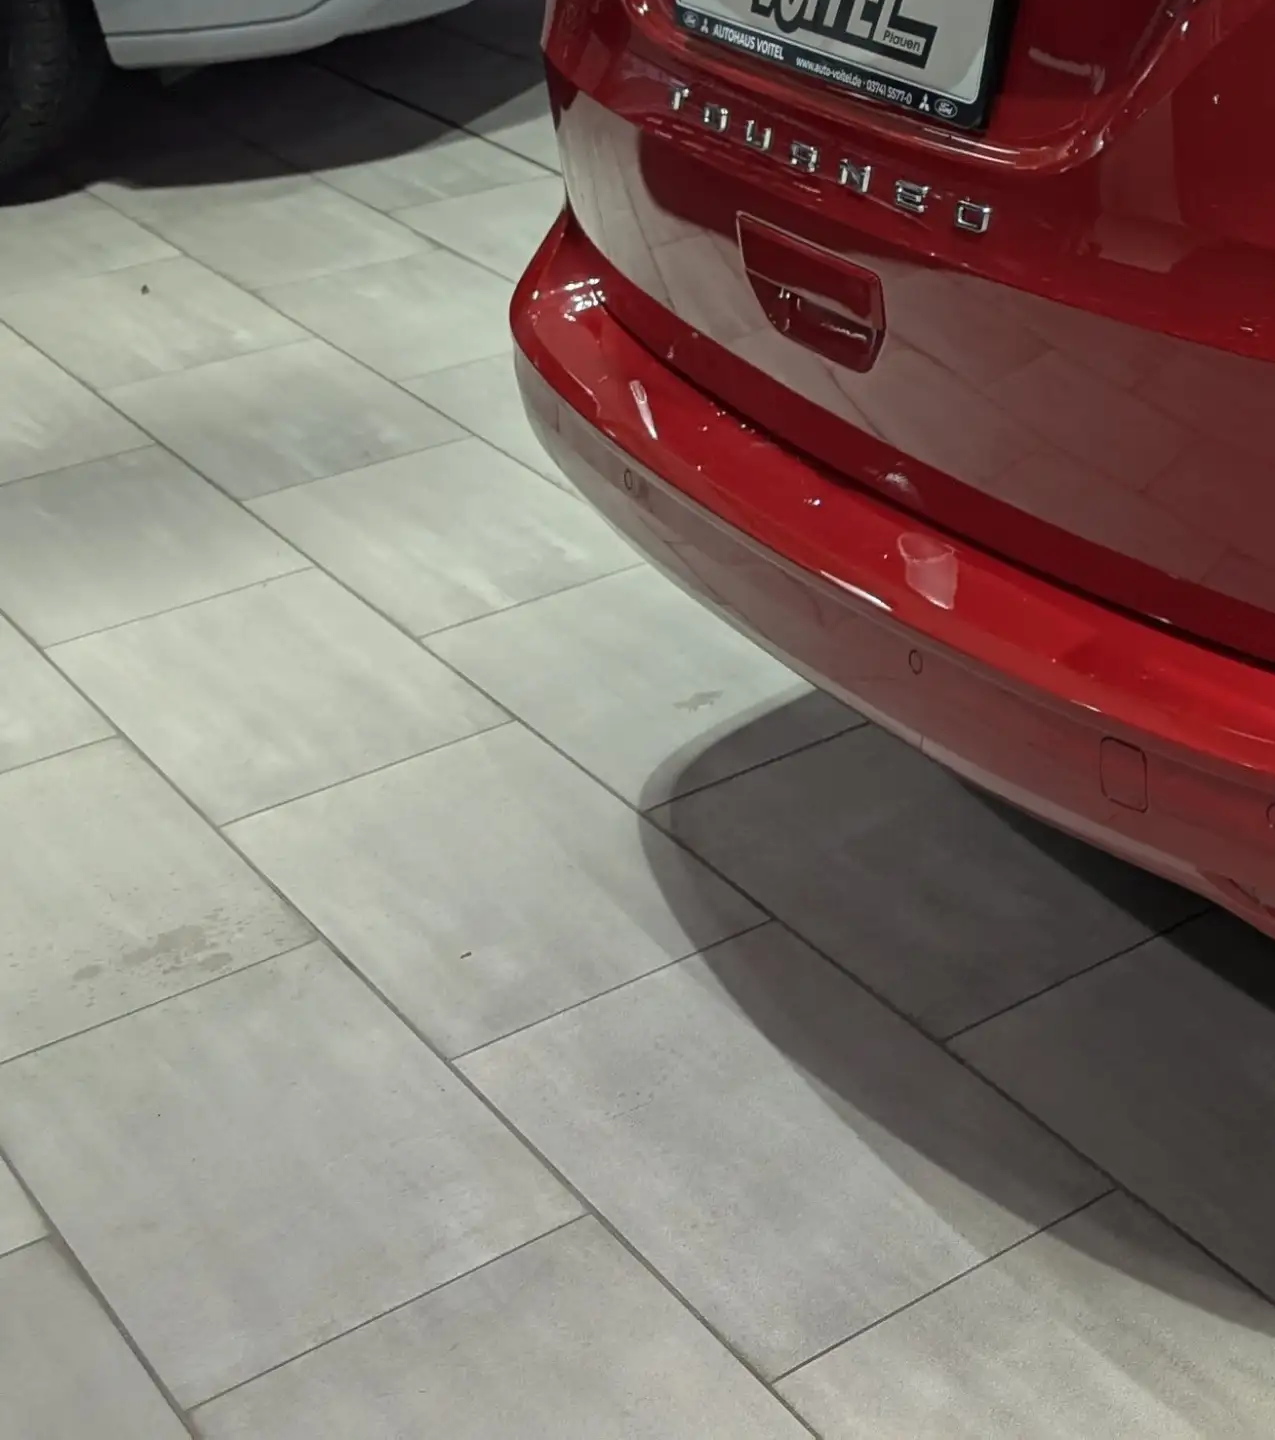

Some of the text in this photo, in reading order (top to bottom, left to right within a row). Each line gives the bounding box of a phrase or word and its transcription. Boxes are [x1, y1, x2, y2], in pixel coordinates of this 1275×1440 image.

[712, 24, 785, 60] AUTOHAUS VOITEL
[883, 30, 921, 52] Plauen
[671, 87, 992, 233] TOURNEO
